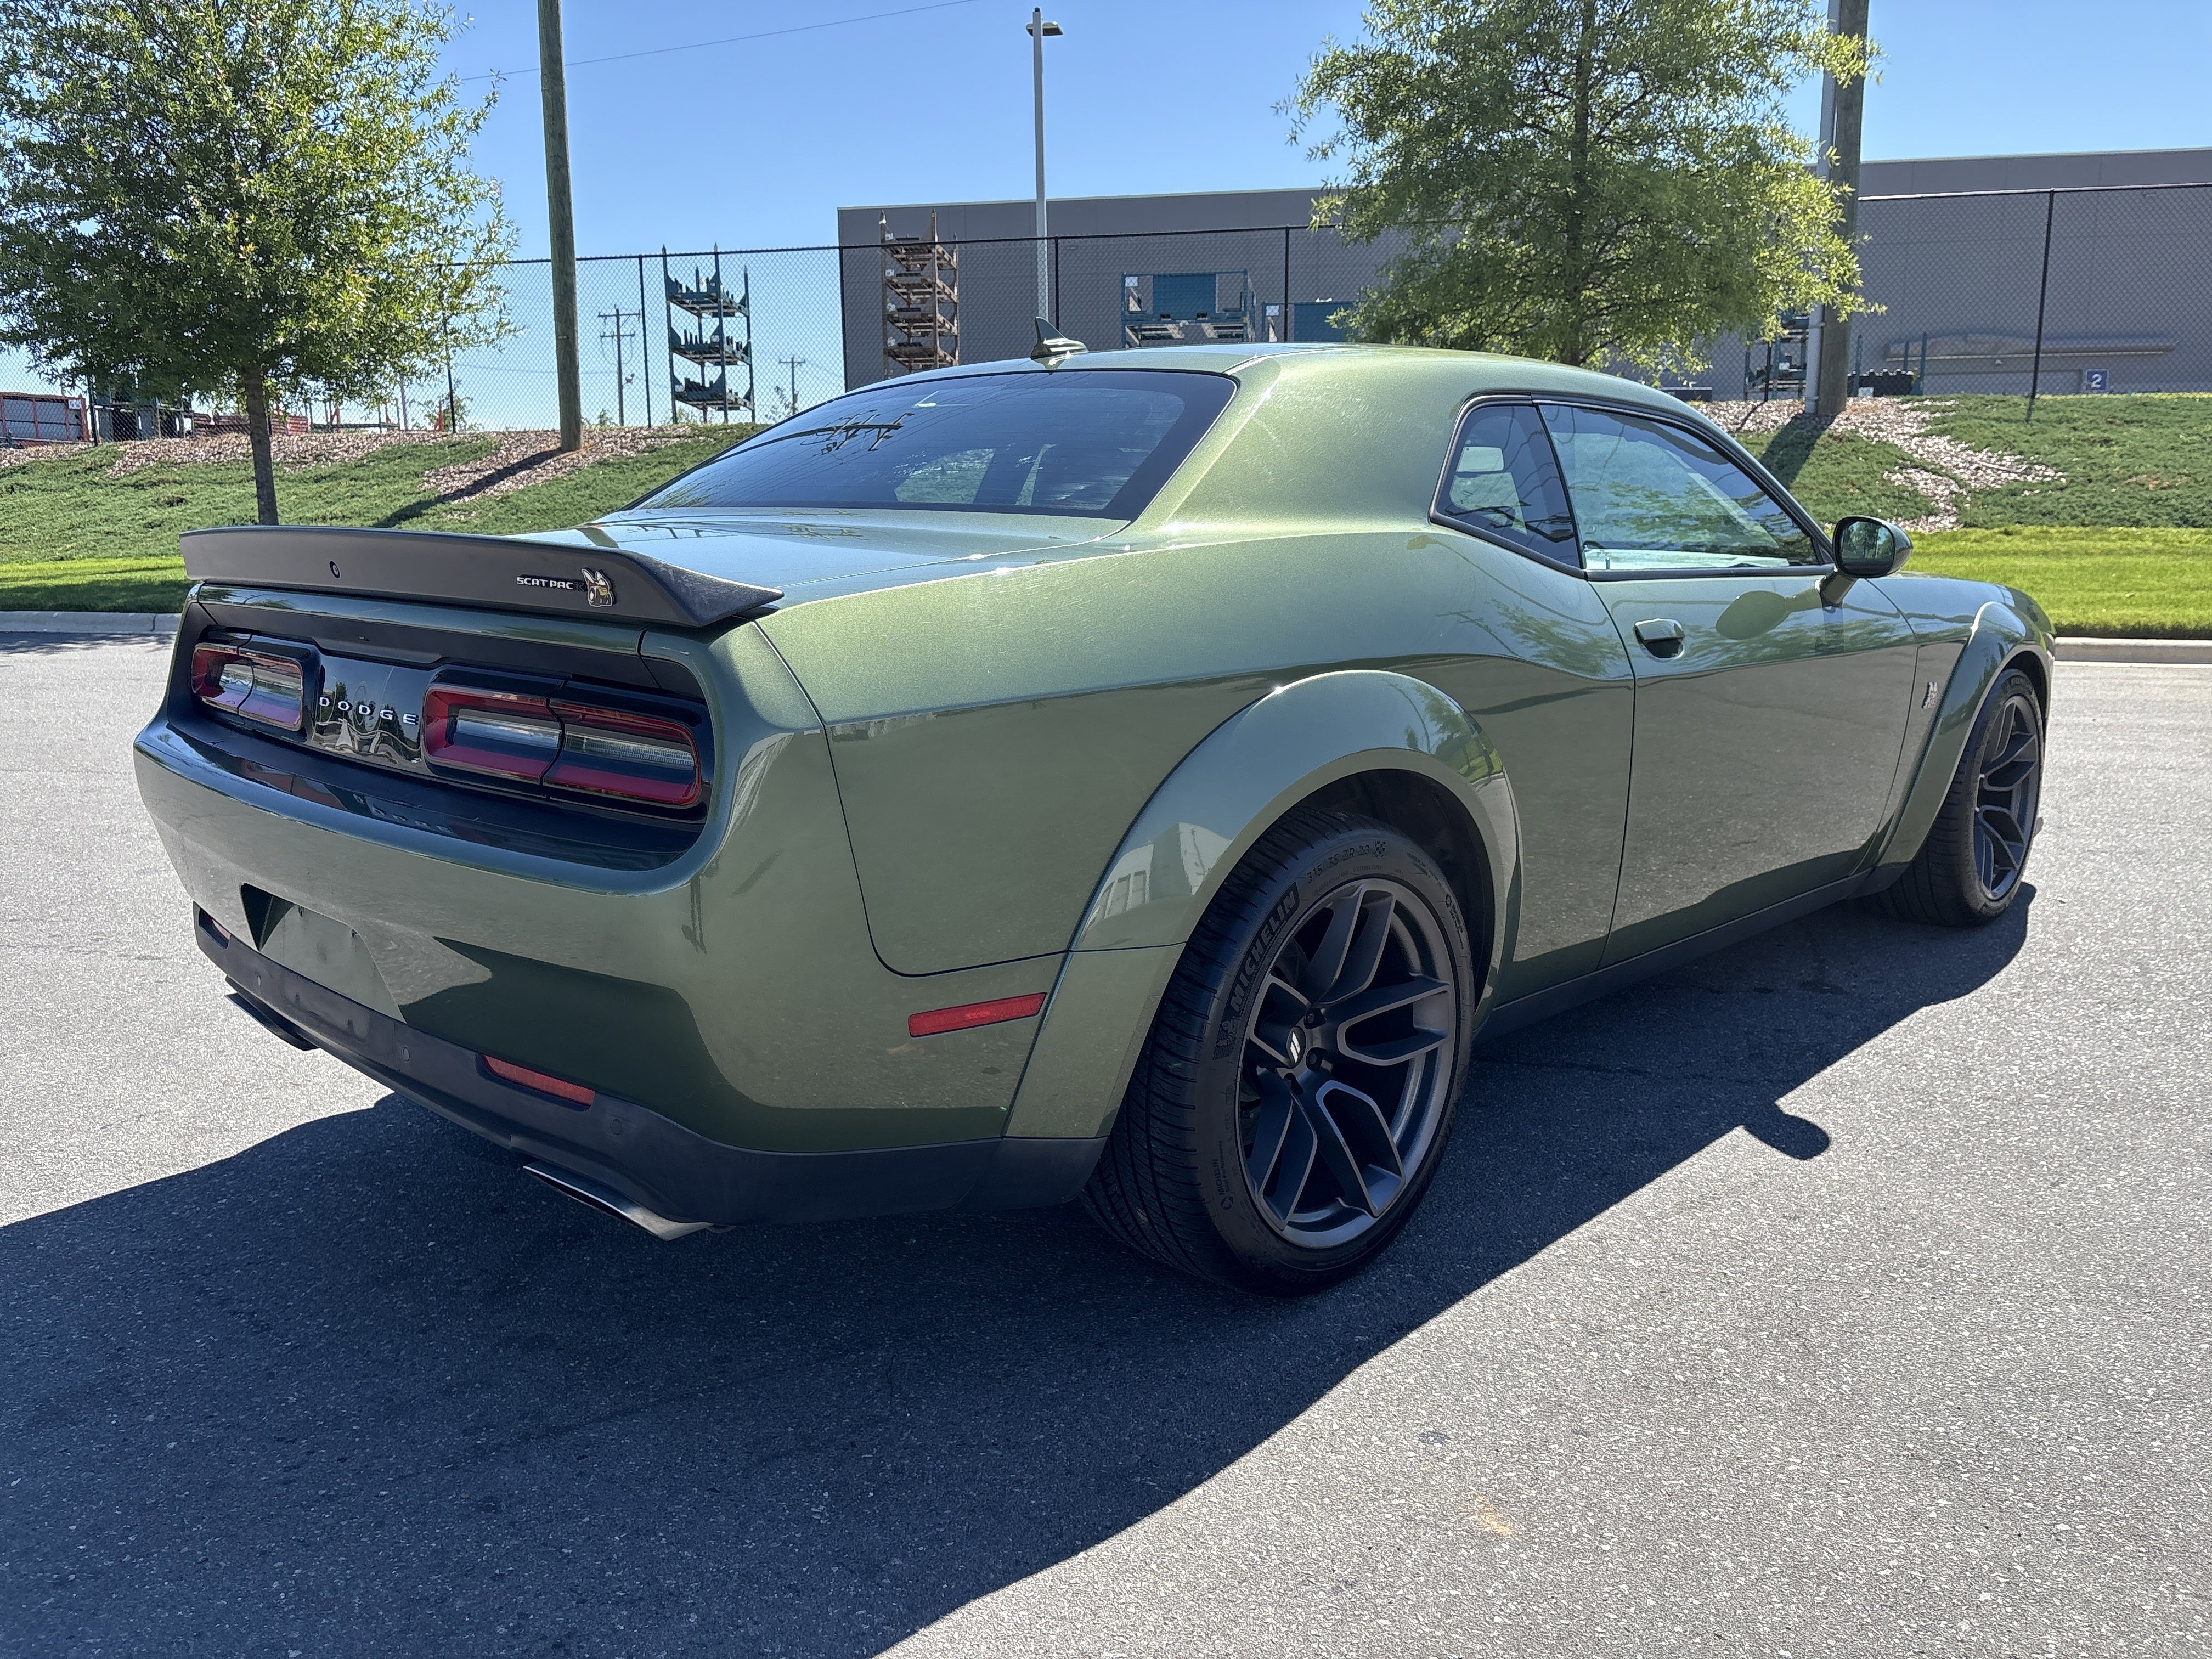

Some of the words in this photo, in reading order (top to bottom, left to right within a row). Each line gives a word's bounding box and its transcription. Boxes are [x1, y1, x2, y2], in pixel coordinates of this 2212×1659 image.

[2091, 373, 2102, 388] 2
[516, 577, 548, 587] SCAT
[319, 696, 419, 725] DODGE
[1230, 890, 1296, 1012] MICHELIN
[1218, 1141, 1227, 1178] Performance
[1212, 1158, 1225, 1196] MICHELIN
